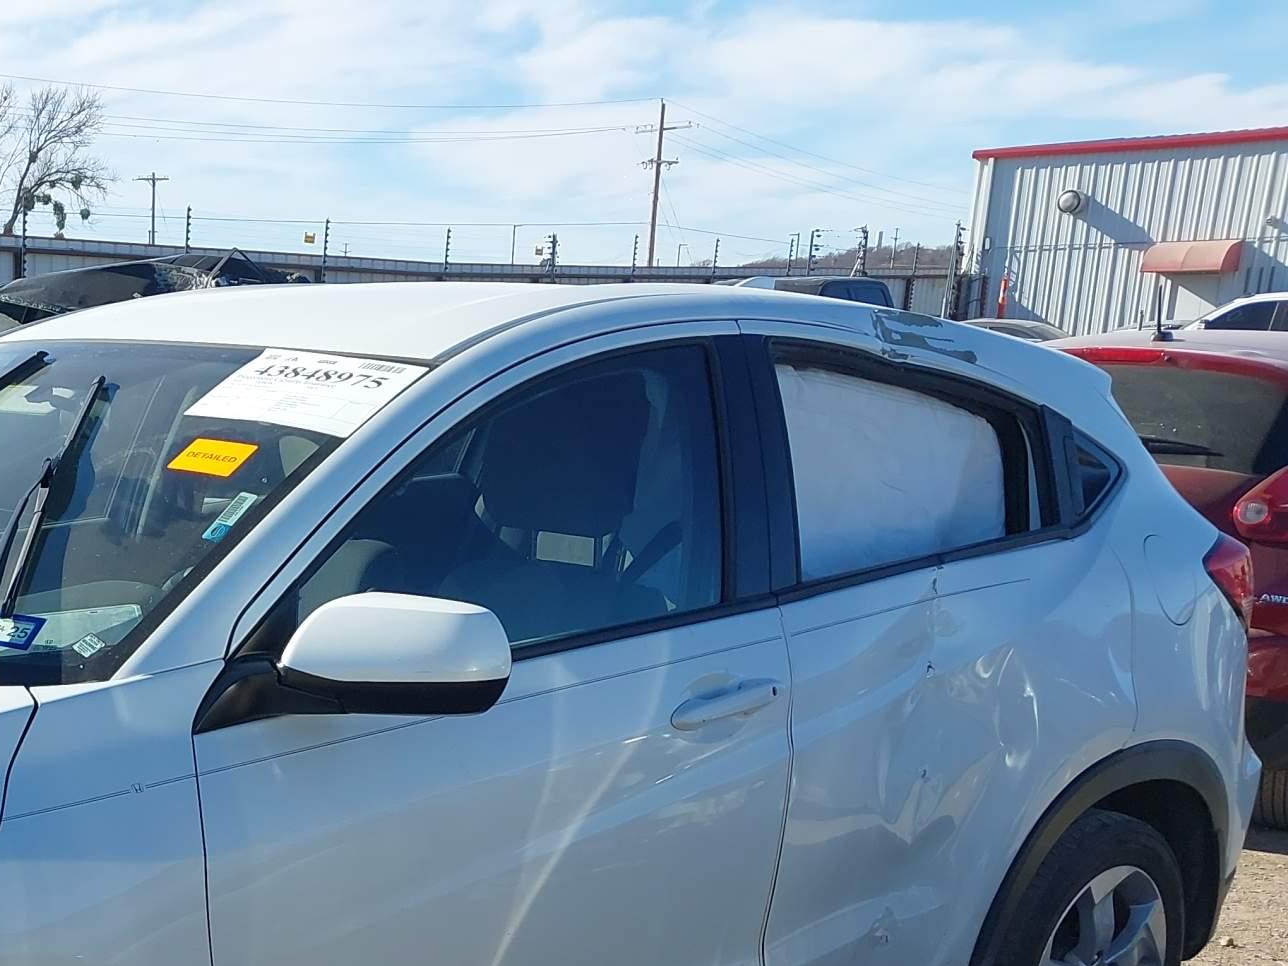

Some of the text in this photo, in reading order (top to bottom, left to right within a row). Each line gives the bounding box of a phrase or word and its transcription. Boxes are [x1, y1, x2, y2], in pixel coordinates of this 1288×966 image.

[255, 364, 389, 389] 43848975
[186, 451, 238, 463] DETAILED
[6, 625, 31, 638] 25
